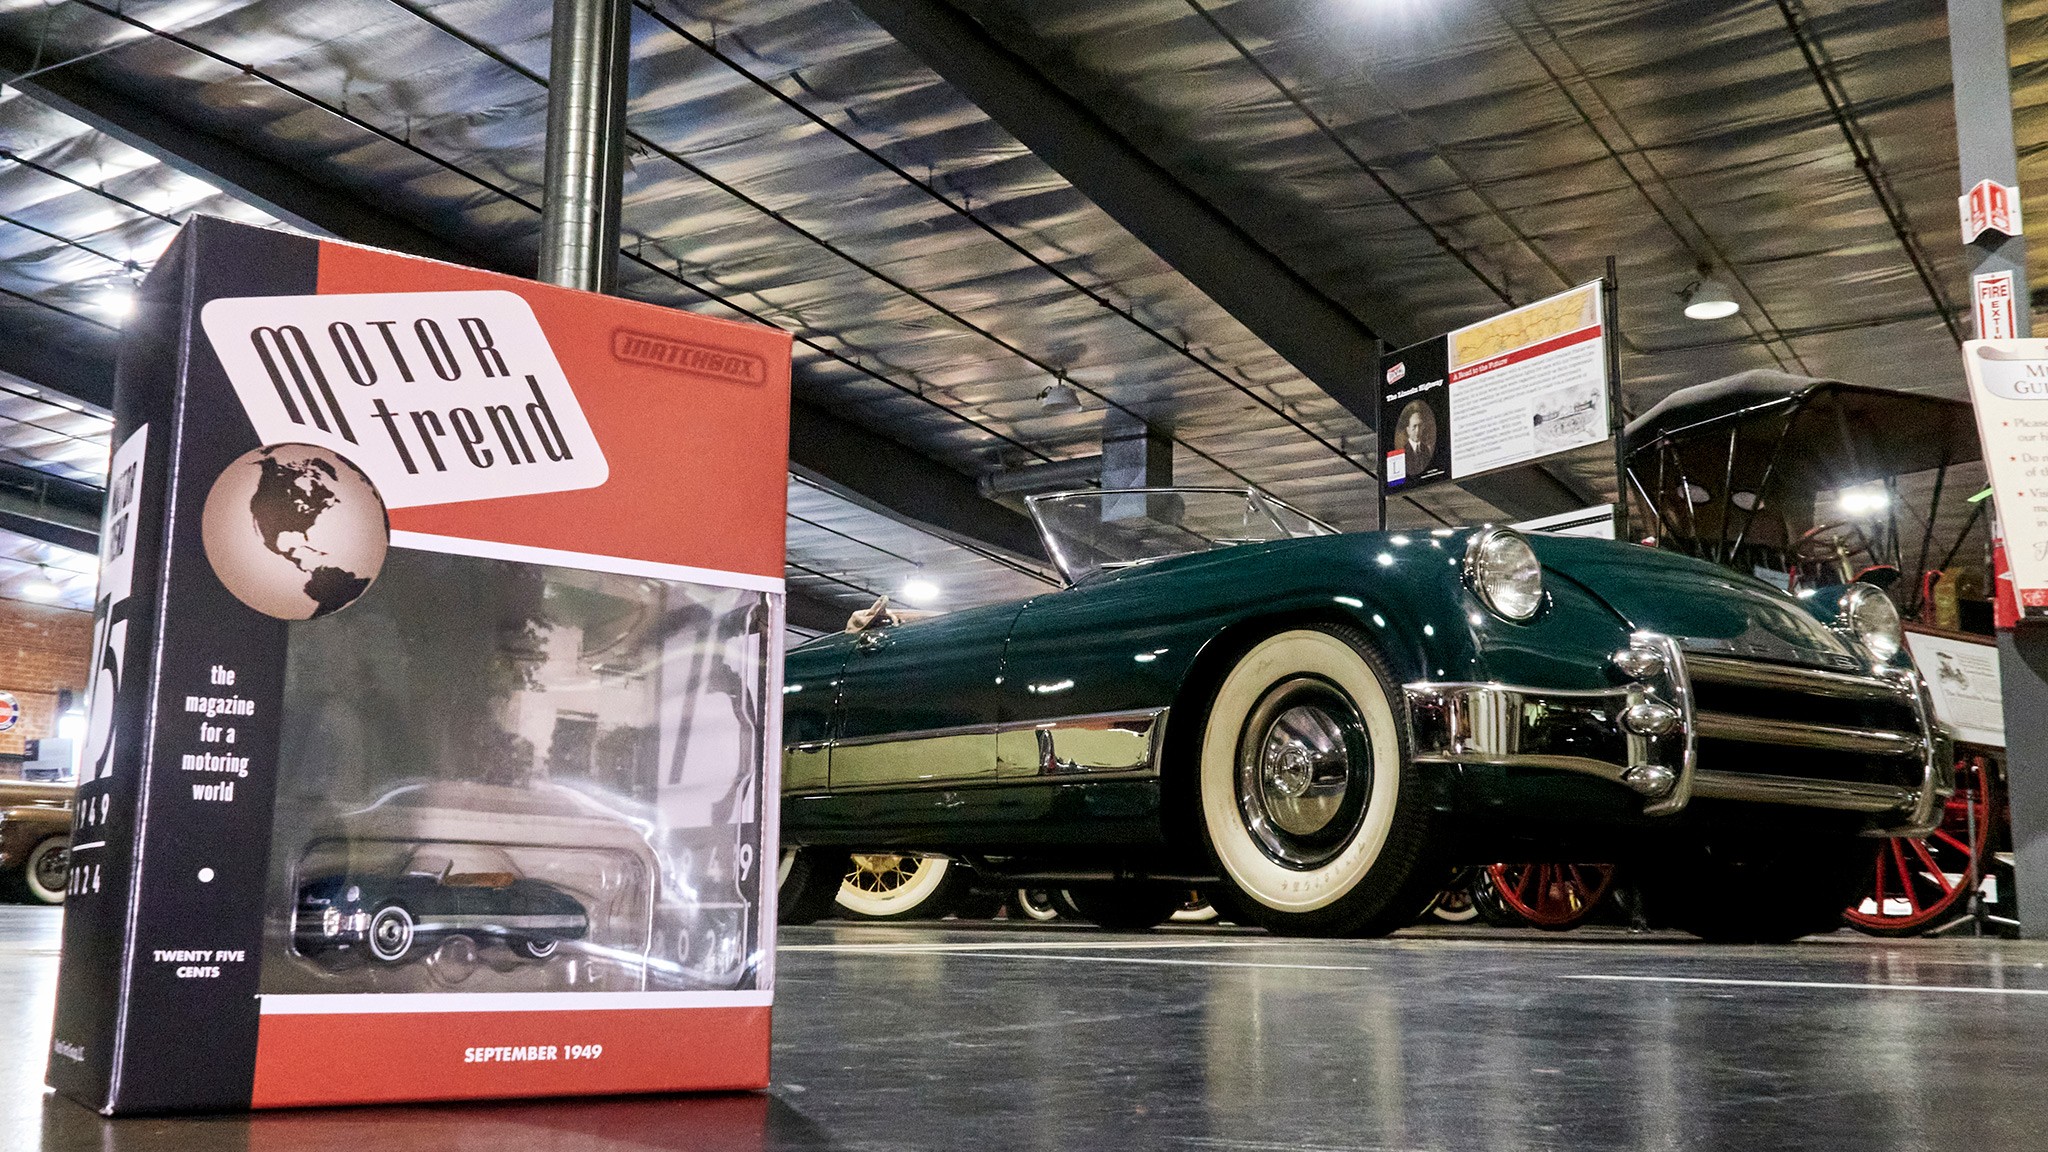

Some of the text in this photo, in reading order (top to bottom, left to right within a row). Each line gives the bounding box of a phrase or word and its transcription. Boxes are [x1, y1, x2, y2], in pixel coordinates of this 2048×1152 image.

[1981, 285, 2008, 299] FIRE
[621, 335, 755, 378] MATCHBOX
[250, 317, 511, 446] MOTOR
[2025, 365, 2048, 377] M
[370, 375, 574, 475] trend
[211, 665, 236, 686] the
[185, 695, 255, 717] magazine
[200, 721, 235, 744] for a
[181, 752, 249, 777] motoring
[192, 782, 234, 801] world
[153, 950, 245, 962] TWENTY FIVE
[176, 967, 220, 978] CENTS
[464, 1044, 603, 1063] SEPTEMBER 1949
